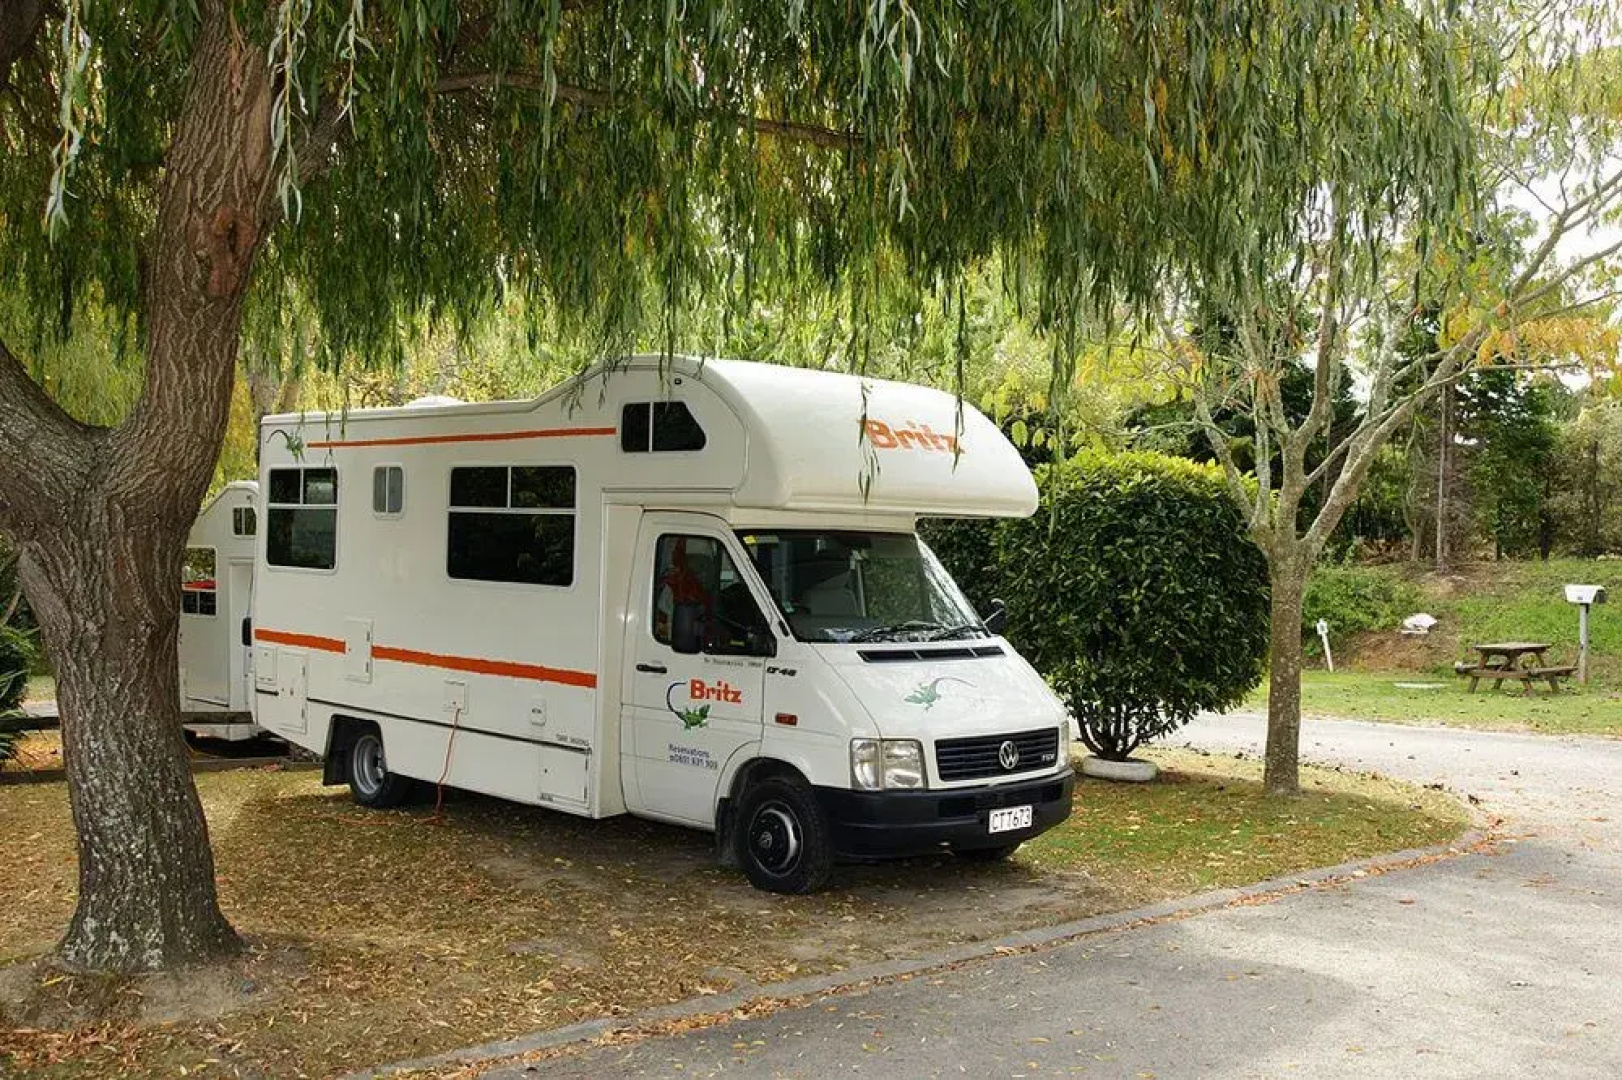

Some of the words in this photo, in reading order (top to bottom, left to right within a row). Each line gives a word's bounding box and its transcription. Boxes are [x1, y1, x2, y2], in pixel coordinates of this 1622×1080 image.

[858, 418, 965, 454] Britz
[690, 679, 742, 703] Britz
[992, 807, 1031, 831] CTT673
